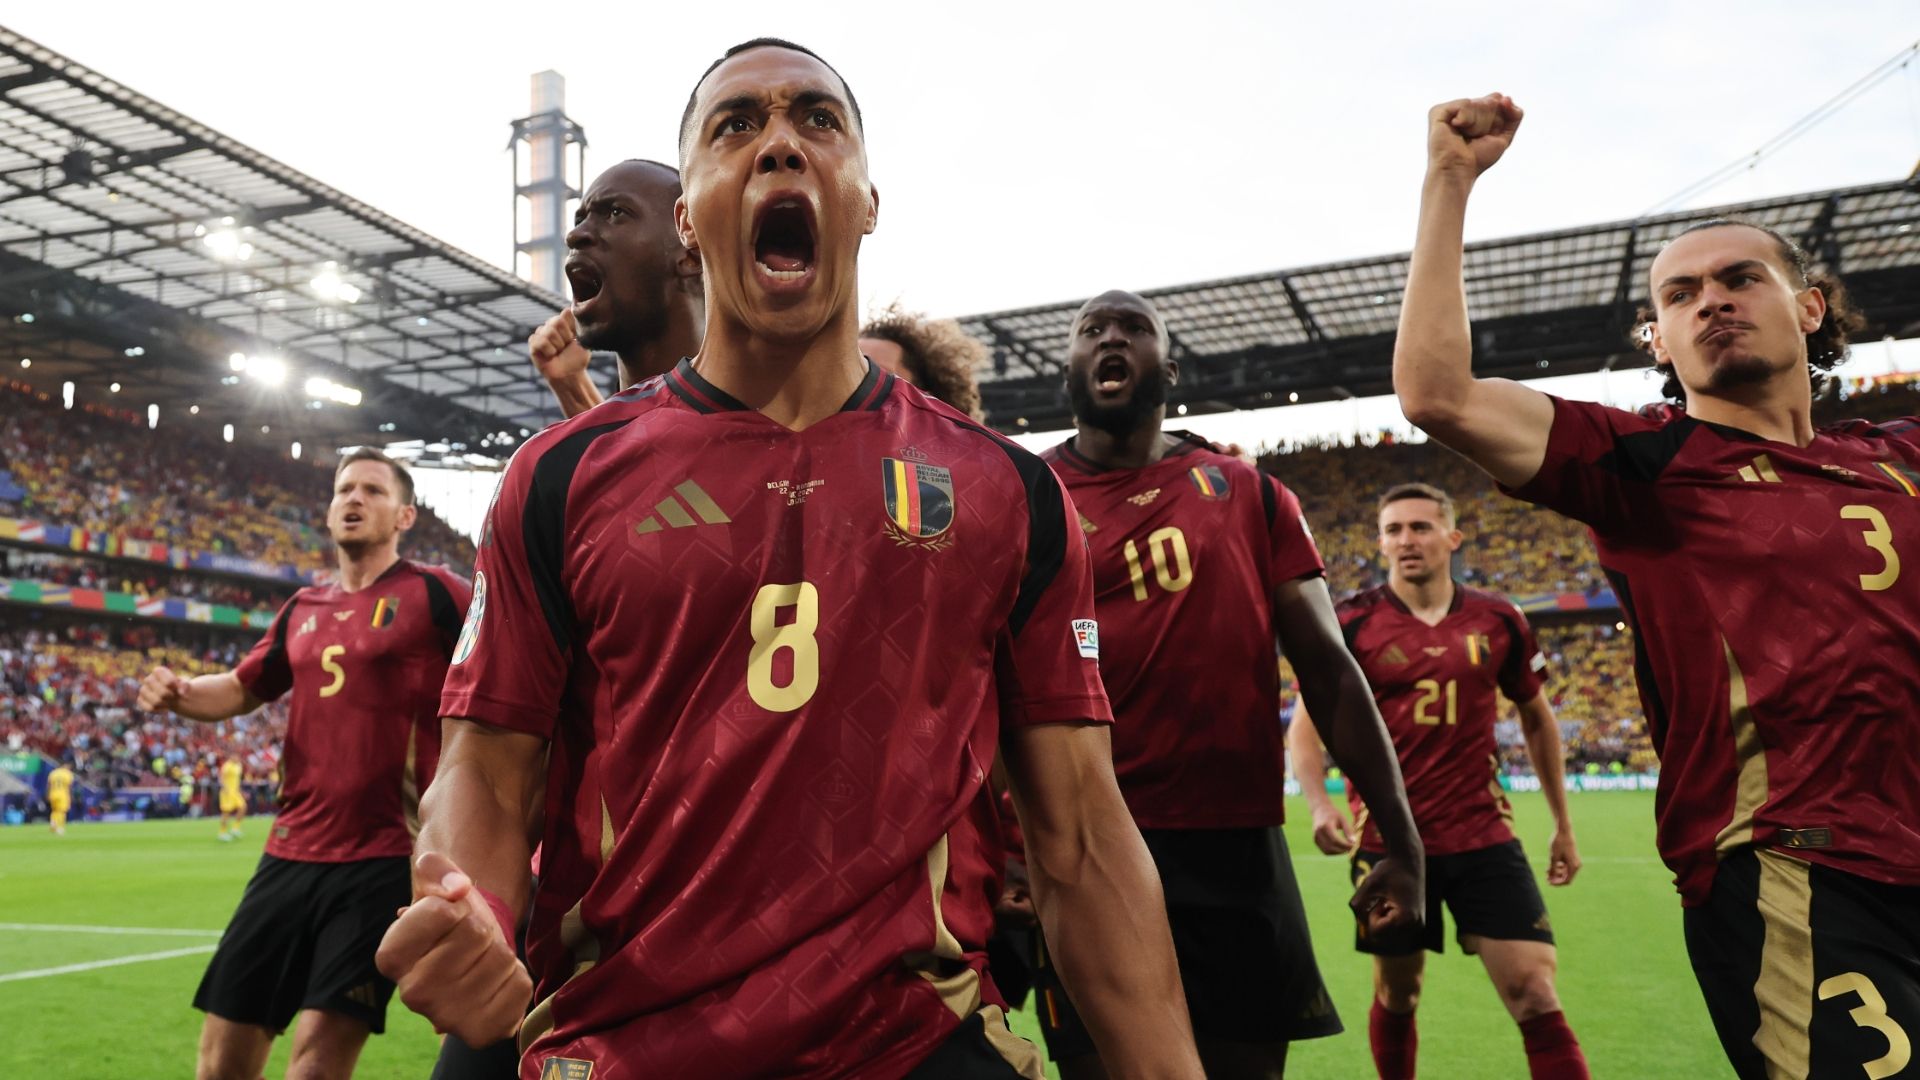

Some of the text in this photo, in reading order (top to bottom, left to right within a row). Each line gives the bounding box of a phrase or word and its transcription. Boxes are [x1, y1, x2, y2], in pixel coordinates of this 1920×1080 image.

[1124, 526, 1193, 602] 10
[1840, 505, 1900, 591] 3
[319, 645, 346, 697] 5
[747, 582, 819, 712] 8
[1414, 679, 1457, 725] 21
[1356, 859, 1373, 888] 2
[1818, 971, 1912, 1080] 3
